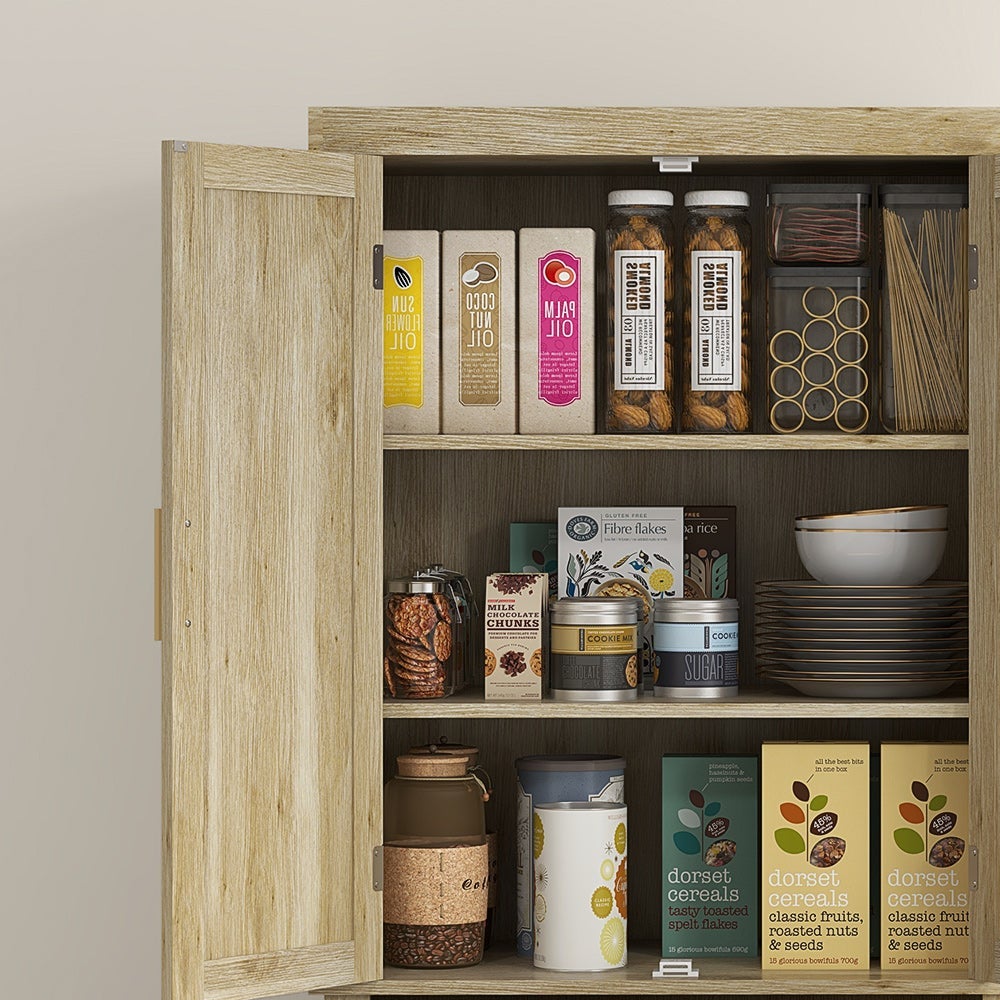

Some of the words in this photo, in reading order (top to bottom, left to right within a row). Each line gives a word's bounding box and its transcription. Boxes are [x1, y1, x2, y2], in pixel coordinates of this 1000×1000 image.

[604, 522, 632, 534] Fibre
[635, 522, 667, 534] flakes
[696, 522, 718, 534] rice
[487, 619, 540, 628] CHUNKS
[587, 635, 621, 643] COOKIE
[684, 653, 724, 681] SUGAR
[668, 867, 732, 884] dorset
[768, 868, 840, 887] dorset
[887, 868, 959, 887] dorset
[668, 886, 740, 902] cereals
[768, 889, 849, 907] cereals
[887, 889, 968, 907] cereals
[668, 905, 701, 918] tasty
[703, 905, 749, 917] toasted
[769, 910, 817, 922] classic
[820, 910, 864, 924] fruits,
[888, 910, 936, 922] classic
[668, 919, 699, 932] spelt
[701, 919, 739, 930] flakes
[769, 925, 822, 937] roasted
[826, 925, 859, 937] nuts
[888, 925, 942, 937] roasted
[769, 939, 782, 951] &
[784, 939, 824, 951] seeds
[888, 939, 901, 951] &
[903, 939, 943, 951] seeds
[769, 957, 777, 965] 15
[779, 957, 808, 966] glorious
[809, 957, 839, 965] bowlfuls
[841, 957, 859, 966] 700g
[888, 957, 896, 965] 15
[898, 957, 927, 966] glorious
[928, 957, 959, 965] bowlfuls
